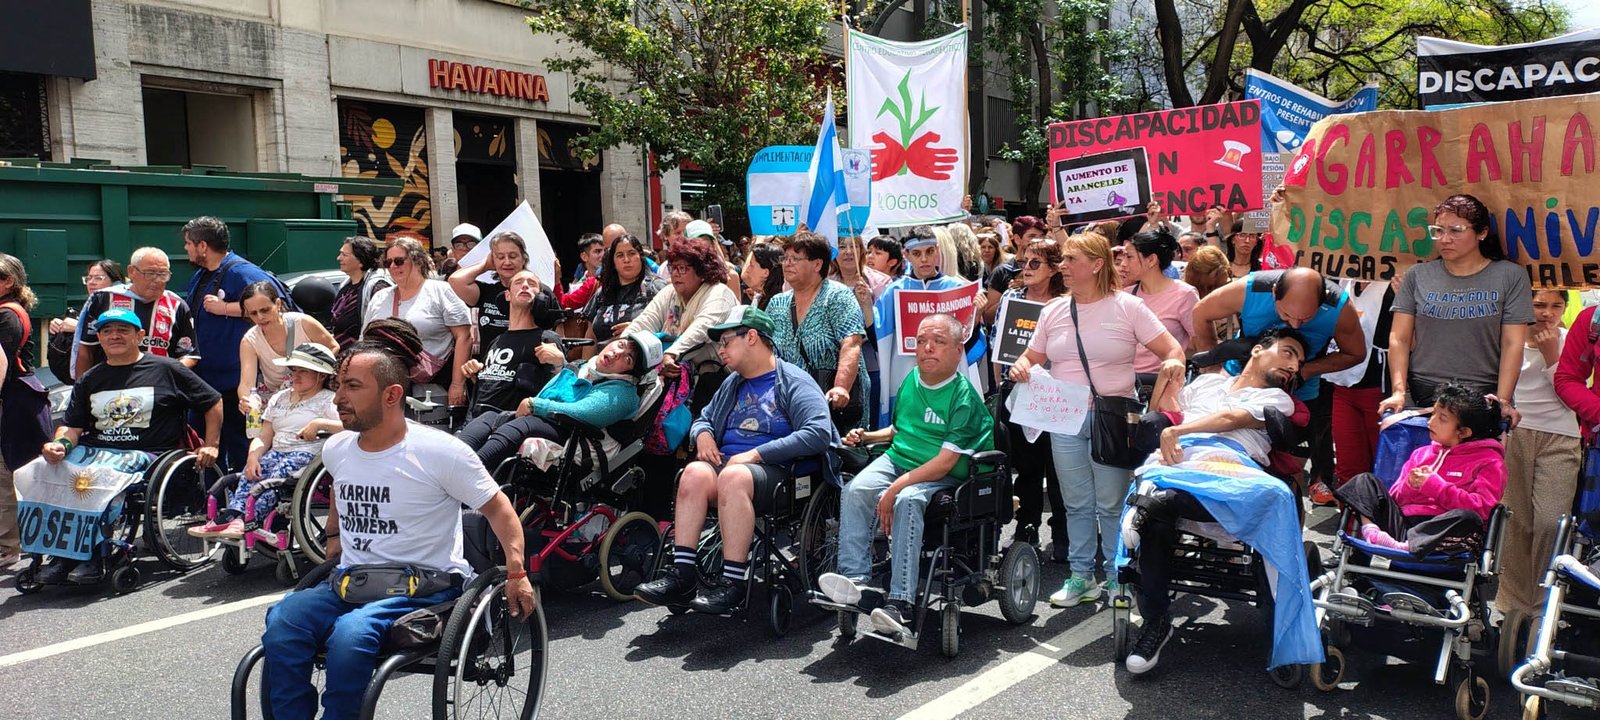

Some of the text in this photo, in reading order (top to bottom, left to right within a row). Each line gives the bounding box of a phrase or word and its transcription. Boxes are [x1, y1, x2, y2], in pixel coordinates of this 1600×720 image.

[428, 58, 549, 102] HAVANNA
[1419, 56, 1600, 94] DISCAPAC
[1248, 84, 1281, 104] ENTROS
[1280, 98, 1292, 109] DE
[1050, 102, 1260, 149] DISCAPACIDAD
[1065, 164, 1128, 182] AUMENTO DE
[1067, 178, 1124, 193] ARANCELES
[878, 192, 939, 210] LOGROS
[1426, 290, 1499, 303] BLACK GOLD
[907, 302, 918, 314] NO
[918, 300, 936, 314] MÁS
[1422, 301, 1499, 320] CALIFORNIA
[1008, 328, 1018, 336] LA
[141, 338, 169, 348] edito
[484, 348, 514, 365] NO
[340, 484, 391, 503] KARINA
[347, 502, 380, 518] ALTA
[43, 510, 75, 550] SE
[352, 537, 373, 552] 3%
